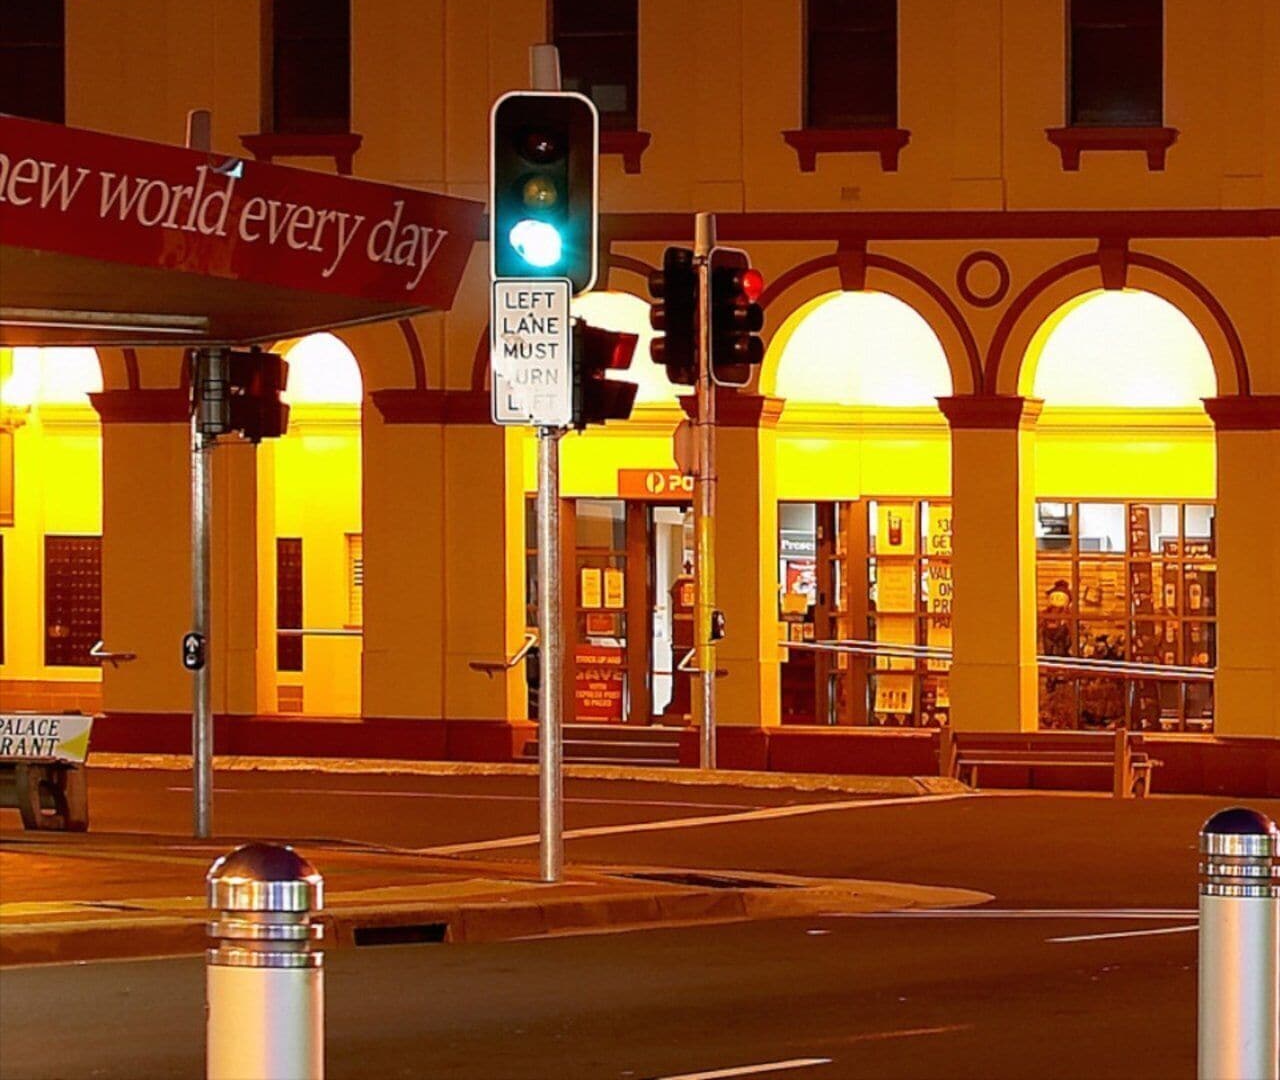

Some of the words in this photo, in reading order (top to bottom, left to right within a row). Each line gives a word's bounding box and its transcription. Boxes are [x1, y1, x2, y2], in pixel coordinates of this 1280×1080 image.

[0, 153, 91, 212] ew
[98, 164, 237, 237] world
[238, 195, 365, 278] every
[367, 200, 448, 291] day
[505, 291, 556, 309] LEFT
[503, 317, 559, 335] LANE
[503, 342, 559, 360] MUST
[508, 368, 559, 386] URN
